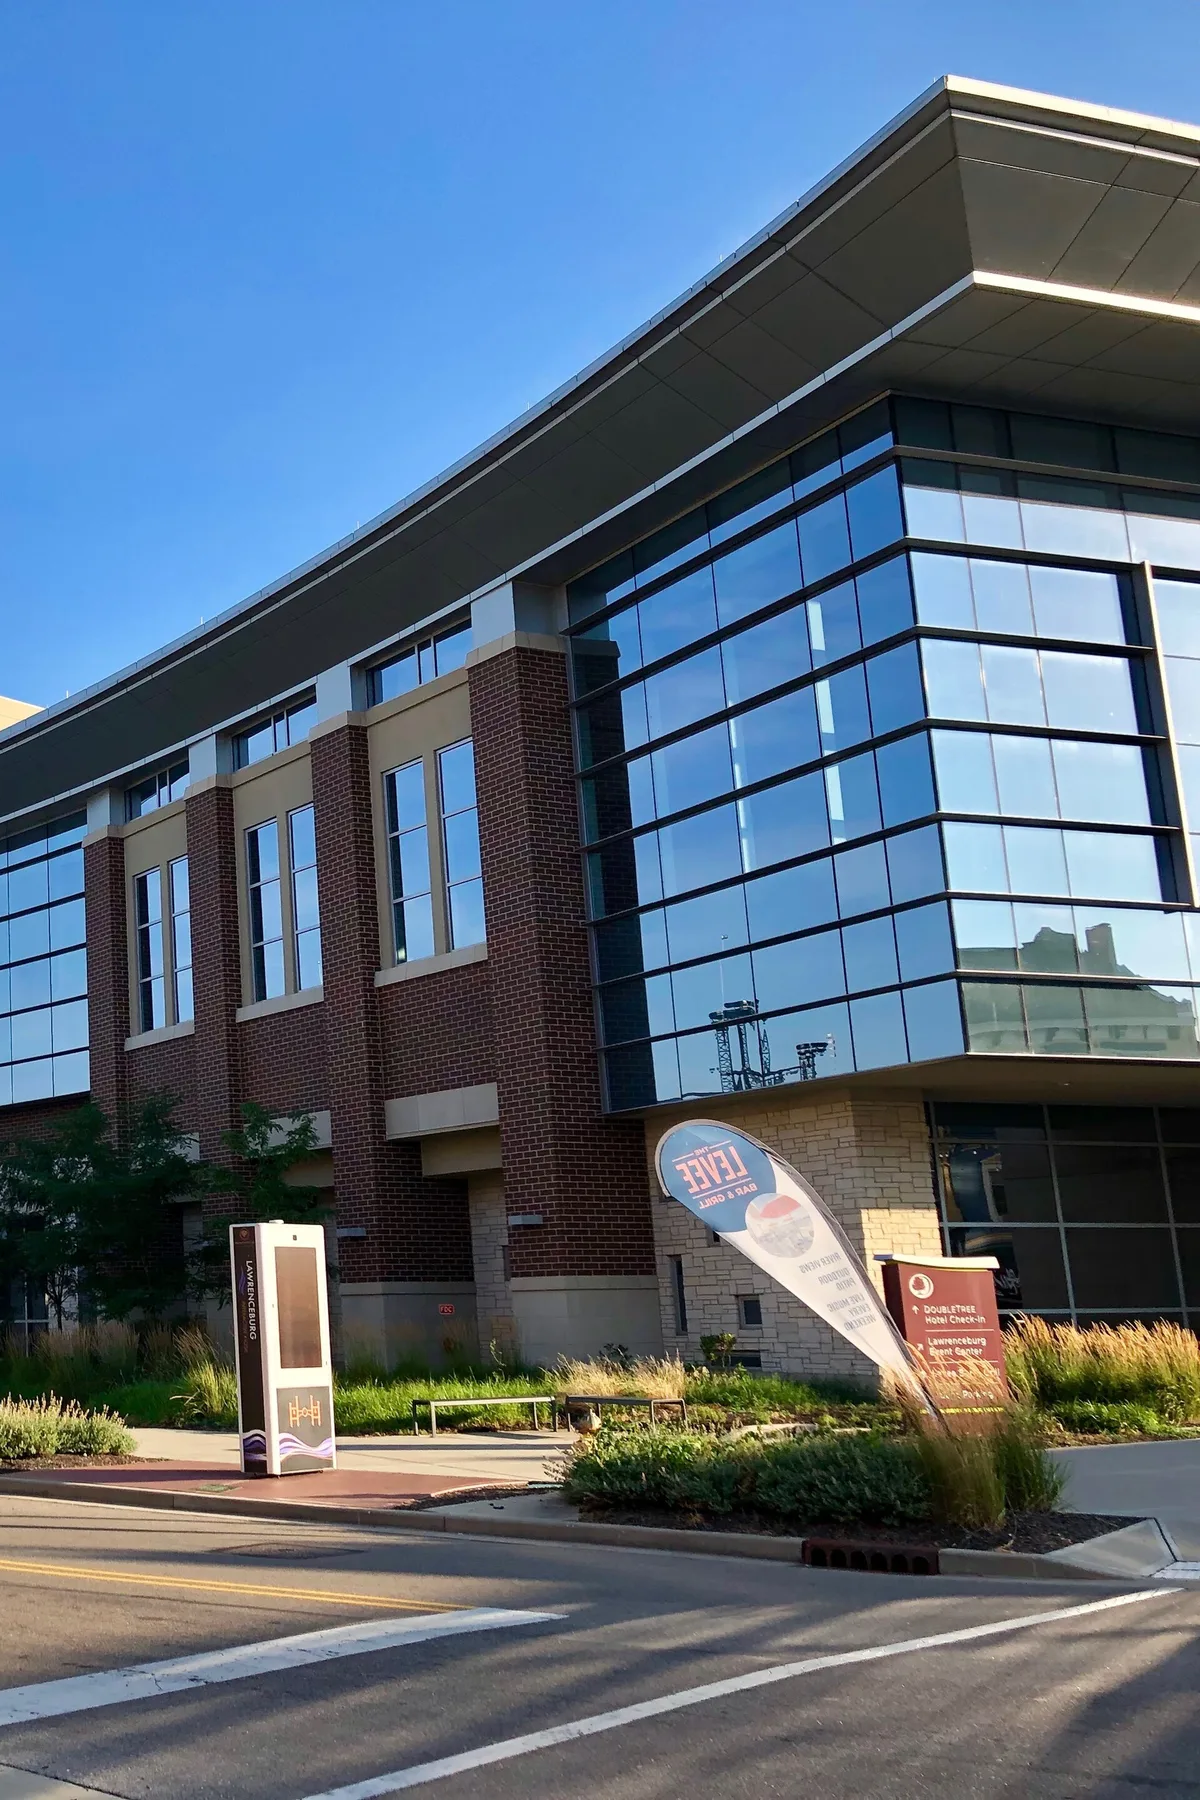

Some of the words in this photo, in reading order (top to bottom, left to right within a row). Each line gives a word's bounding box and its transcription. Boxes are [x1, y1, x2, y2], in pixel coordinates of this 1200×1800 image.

[246, 1260, 257, 1340] LAWRENCEBURG
[925, 1315, 948, 1325] Hotel
[927, 1336, 987, 1347] Lawrenceburg
[954, 1346, 983, 1356] Center
